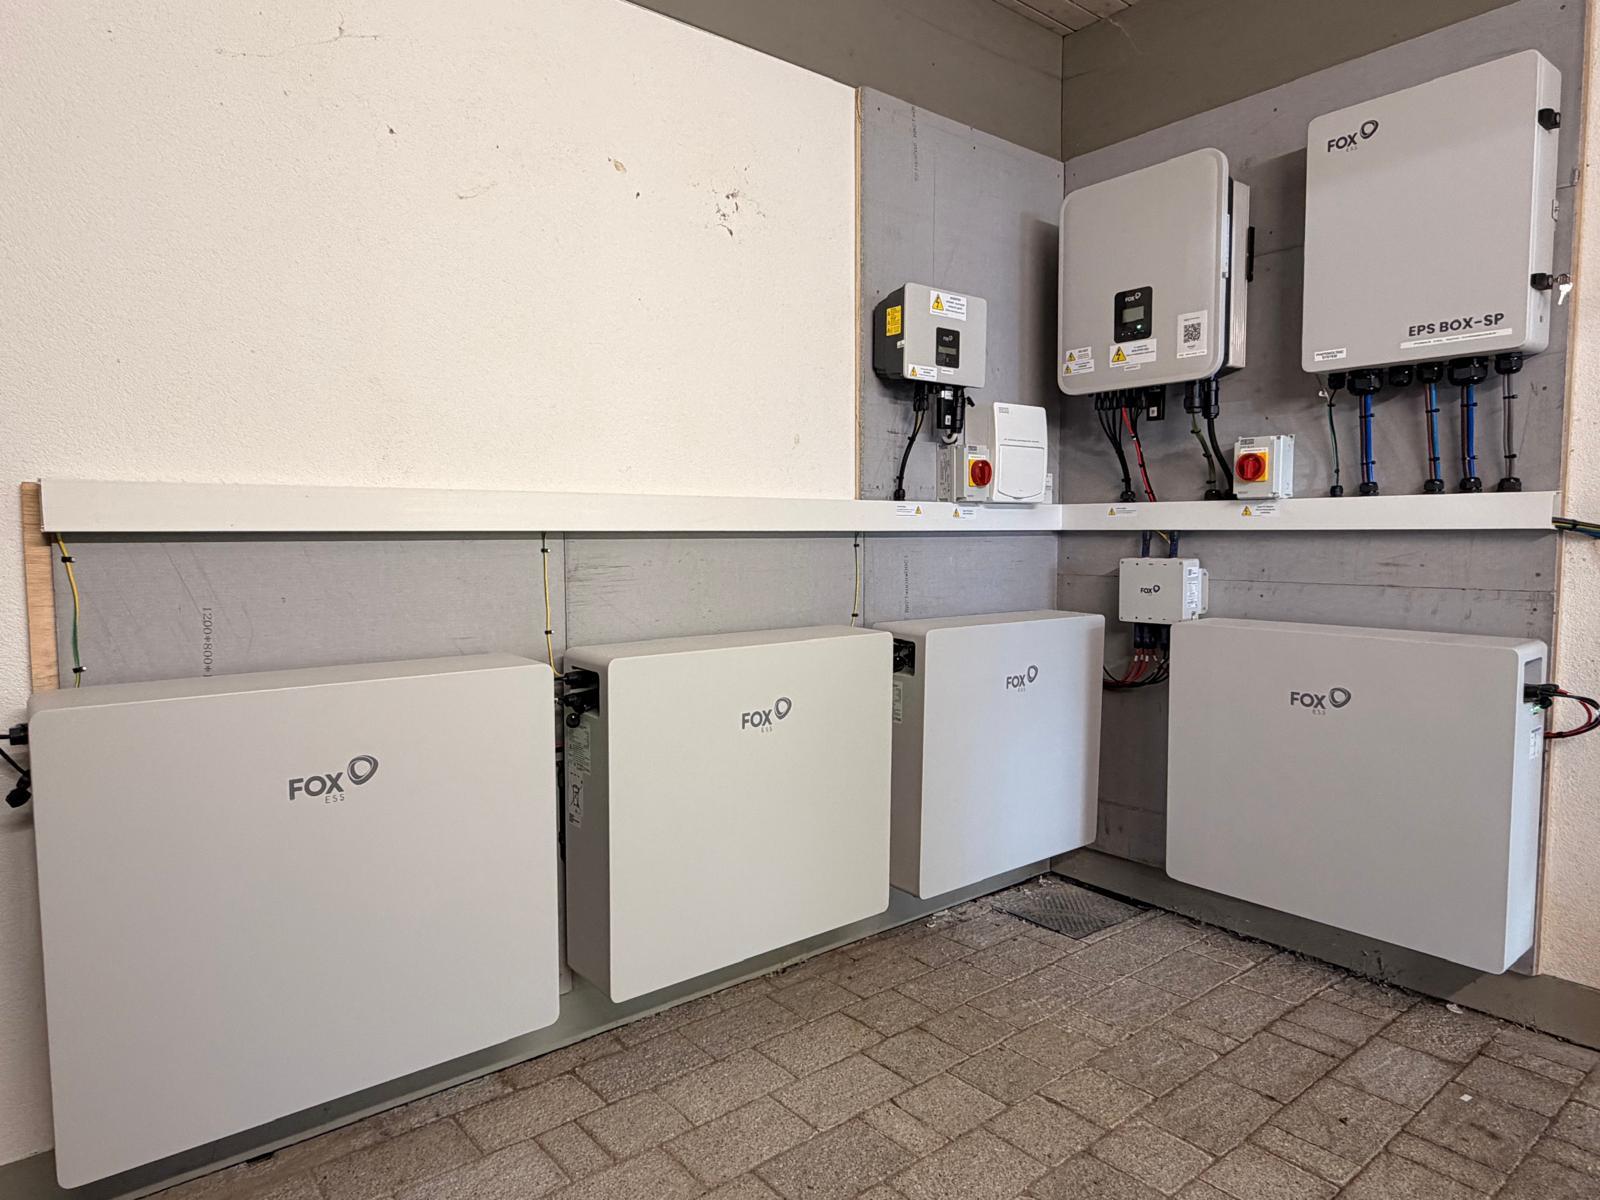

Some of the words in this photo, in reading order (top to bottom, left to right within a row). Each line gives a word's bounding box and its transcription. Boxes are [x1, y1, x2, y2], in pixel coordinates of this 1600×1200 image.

[1327, 132, 1358, 152] FOX
[1408, 323, 1436, 337] EPS
[1439, 313, 1505, 333] BOX-SP
[1006, 674, 1026, 690] FOX
[1290, 691, 1326, 710] FOX
[741, 709, 773, 730] FOX
[289, 772, 344, 801] FOX
[324, 793, 345, 804] ESS
